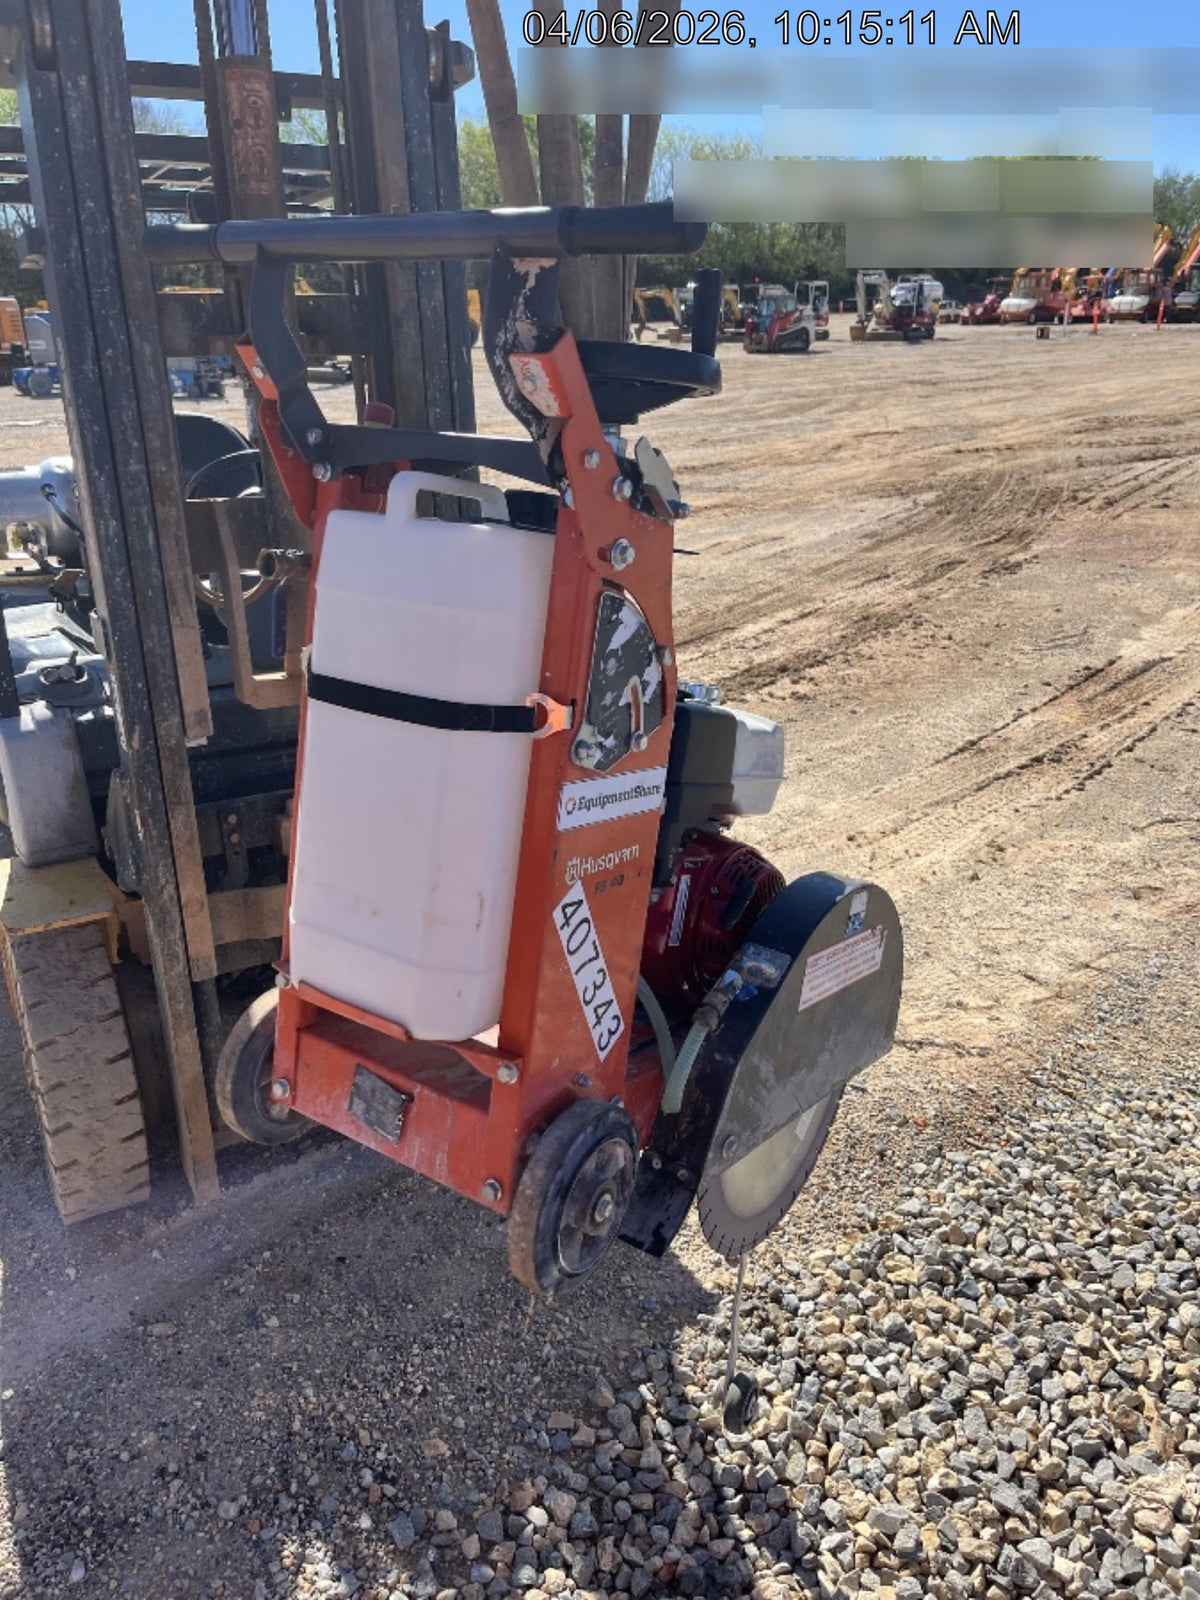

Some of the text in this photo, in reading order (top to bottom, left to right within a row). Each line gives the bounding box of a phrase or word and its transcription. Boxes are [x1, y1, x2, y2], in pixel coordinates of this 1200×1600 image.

[577, 784, 661, 812] EquipmentShare
[580, 844, 640, 877] Husqvarn
[560, 899, 621, 1051] 407343
